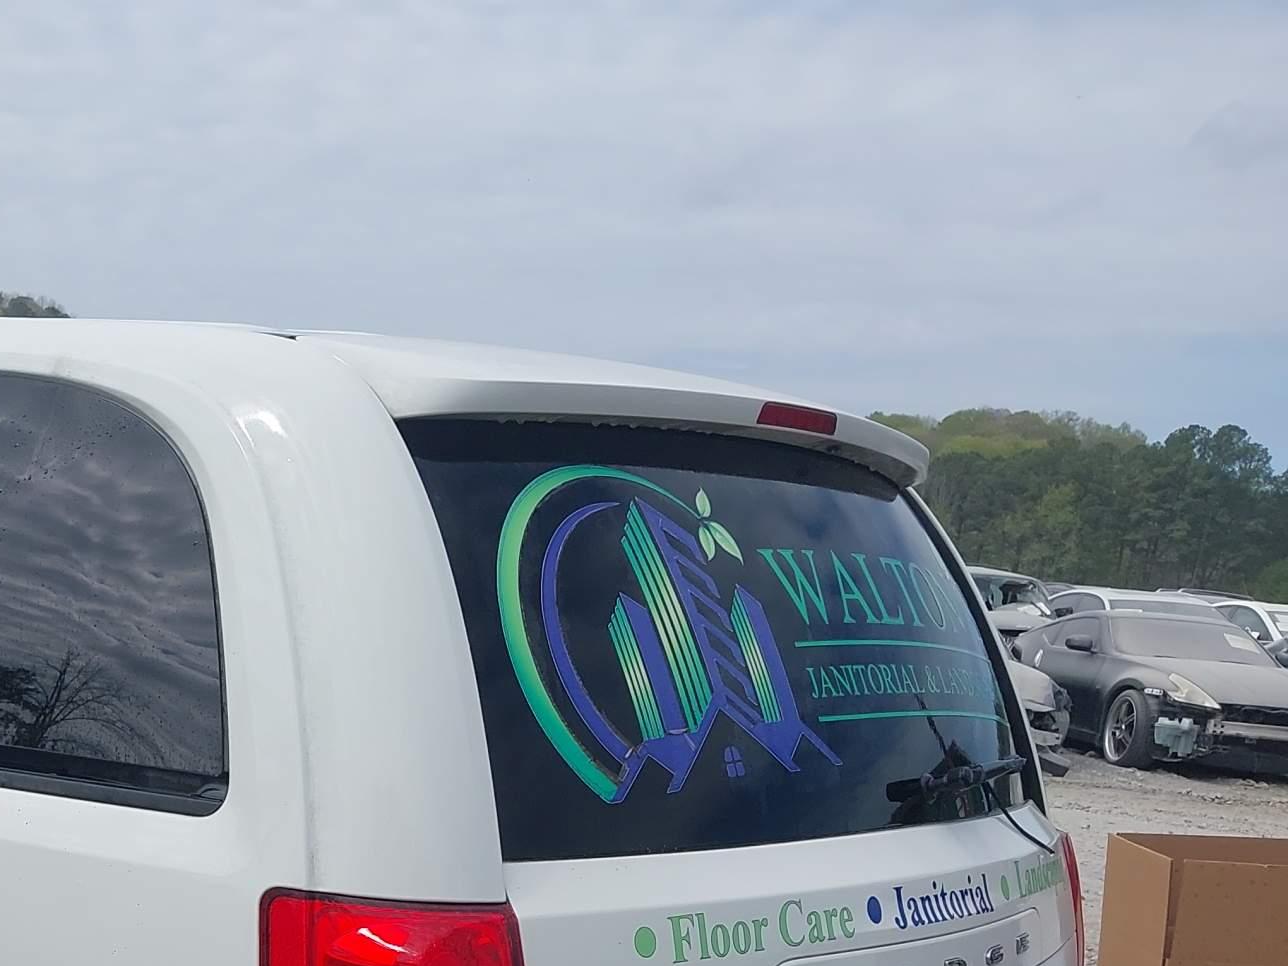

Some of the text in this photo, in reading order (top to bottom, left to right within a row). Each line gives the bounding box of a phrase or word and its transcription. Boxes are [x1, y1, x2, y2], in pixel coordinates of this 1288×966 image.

[806, 663, 926, 699] JANITORIAL
[925, 665, 942, 694] &
[667, 911, 768, 964] Floor
[778, 898, 856, 948] Care
[892, 873, 995, 931] Janitorial
